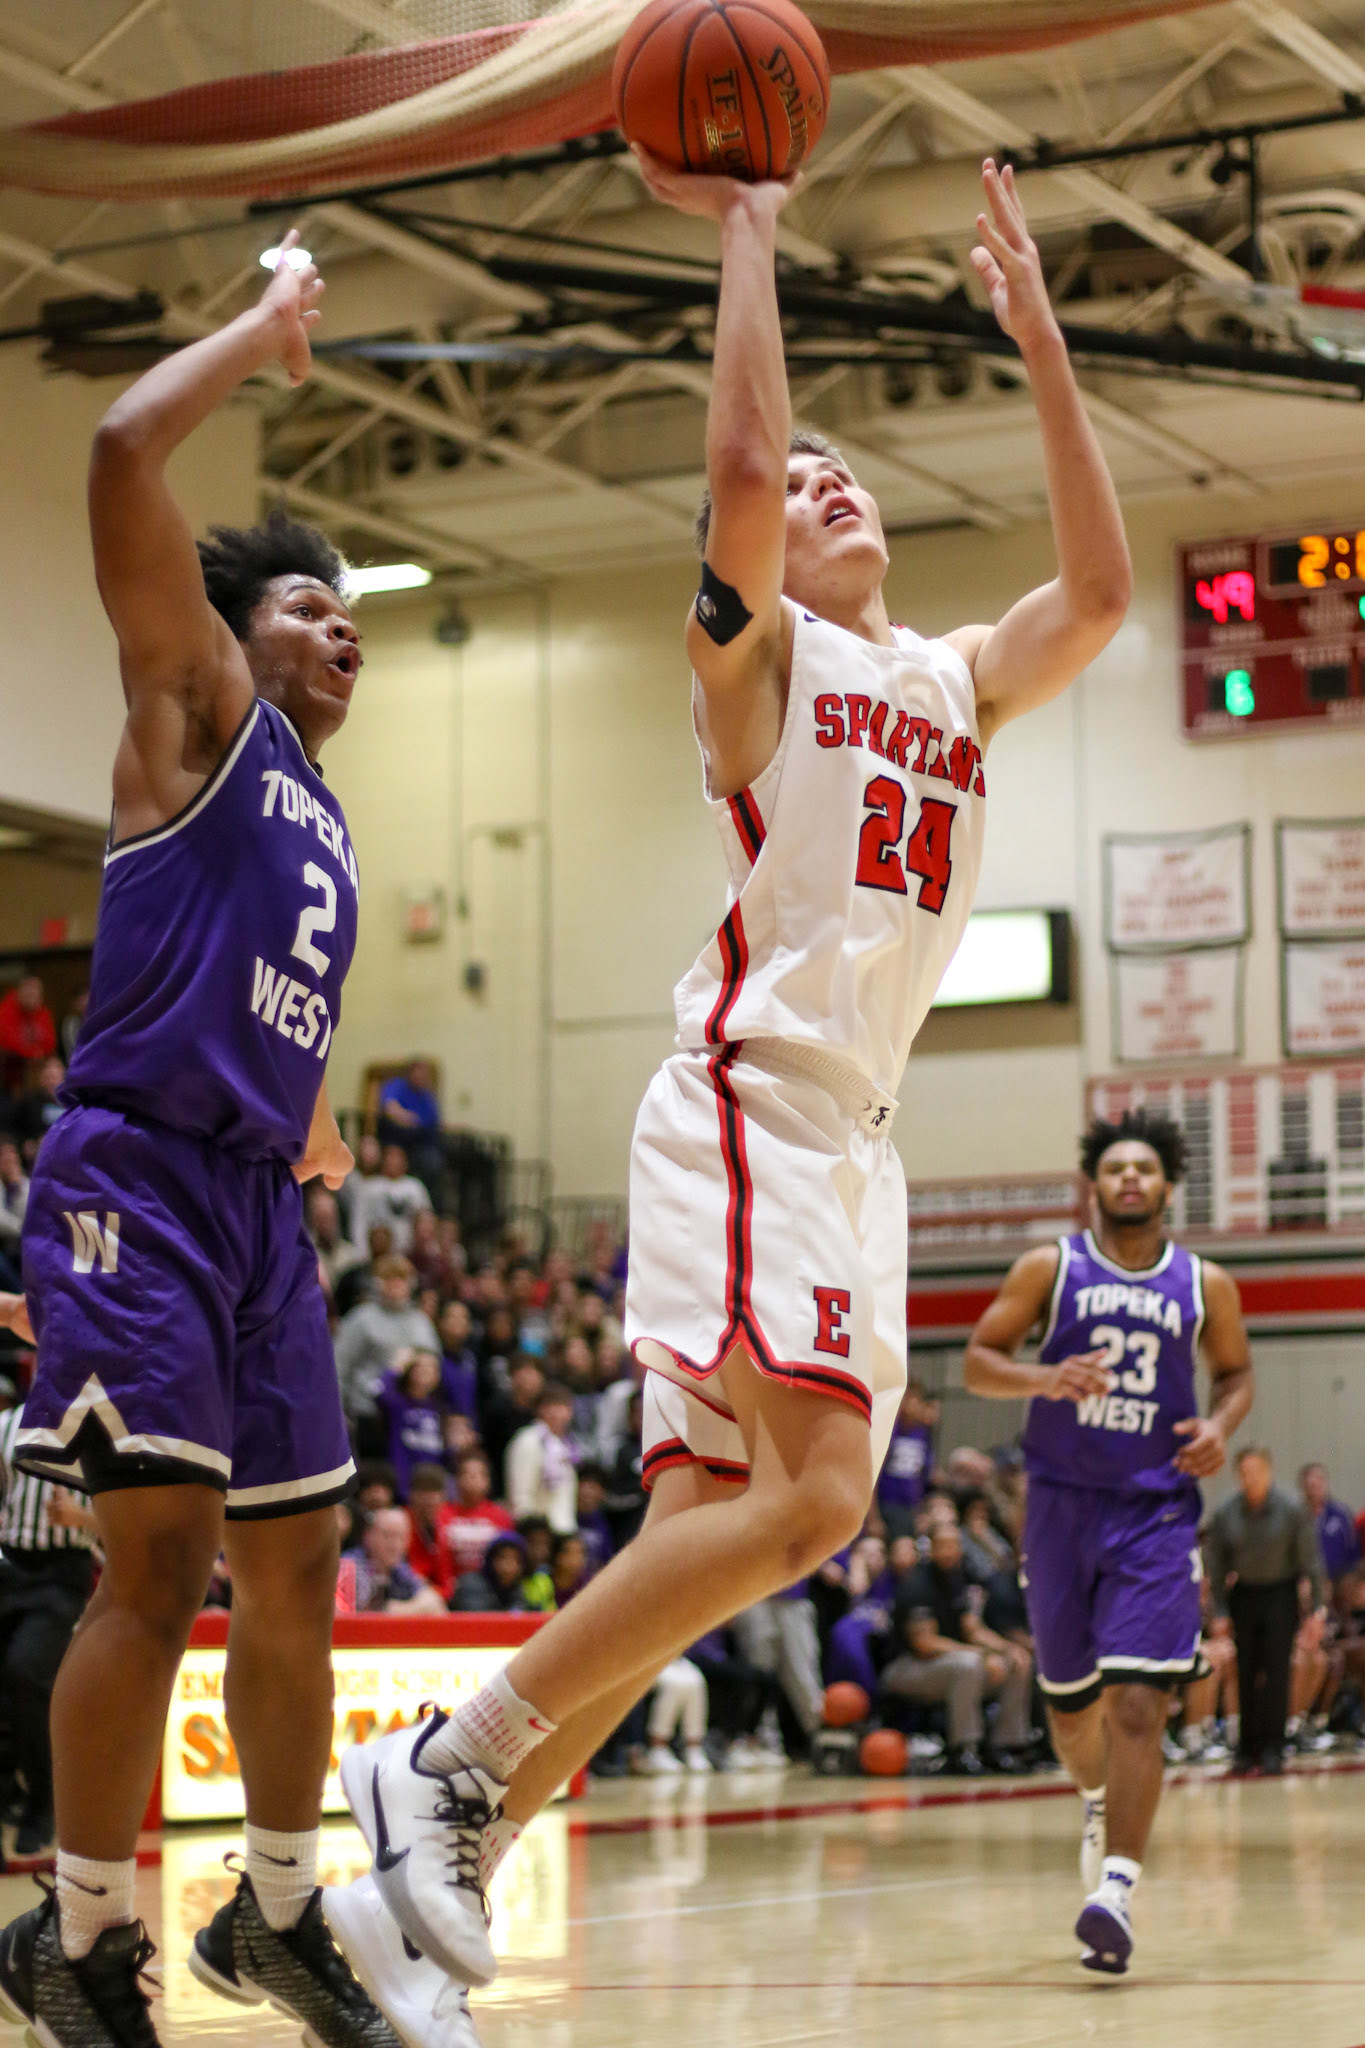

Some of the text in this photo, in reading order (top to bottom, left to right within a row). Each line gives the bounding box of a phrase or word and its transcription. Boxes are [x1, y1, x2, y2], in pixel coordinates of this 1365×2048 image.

[758, 45, 807, 172] SPALDI
[1298, 531, 1365, 588] 2:
[1196, 571, 1255, 624] 49
[1225, 669, 1255, 716] 6
[814, 693, 986, 798] SPARTANS
[261, 769, 359, 901] TOPEKA
[855, 774, 958, 917] 24
[290, 861, 337, 978] 2
[250, 955, 331, 1060] WEST
[62, 1210, 120, 1274] W
[813, 1285, 850, 1358] E
[1074, 1283, 1182, 1339] TOPEKA
[1089, 1324, 1161, 1395] 23
[1076, 1393, 1160, 1436] WEST
